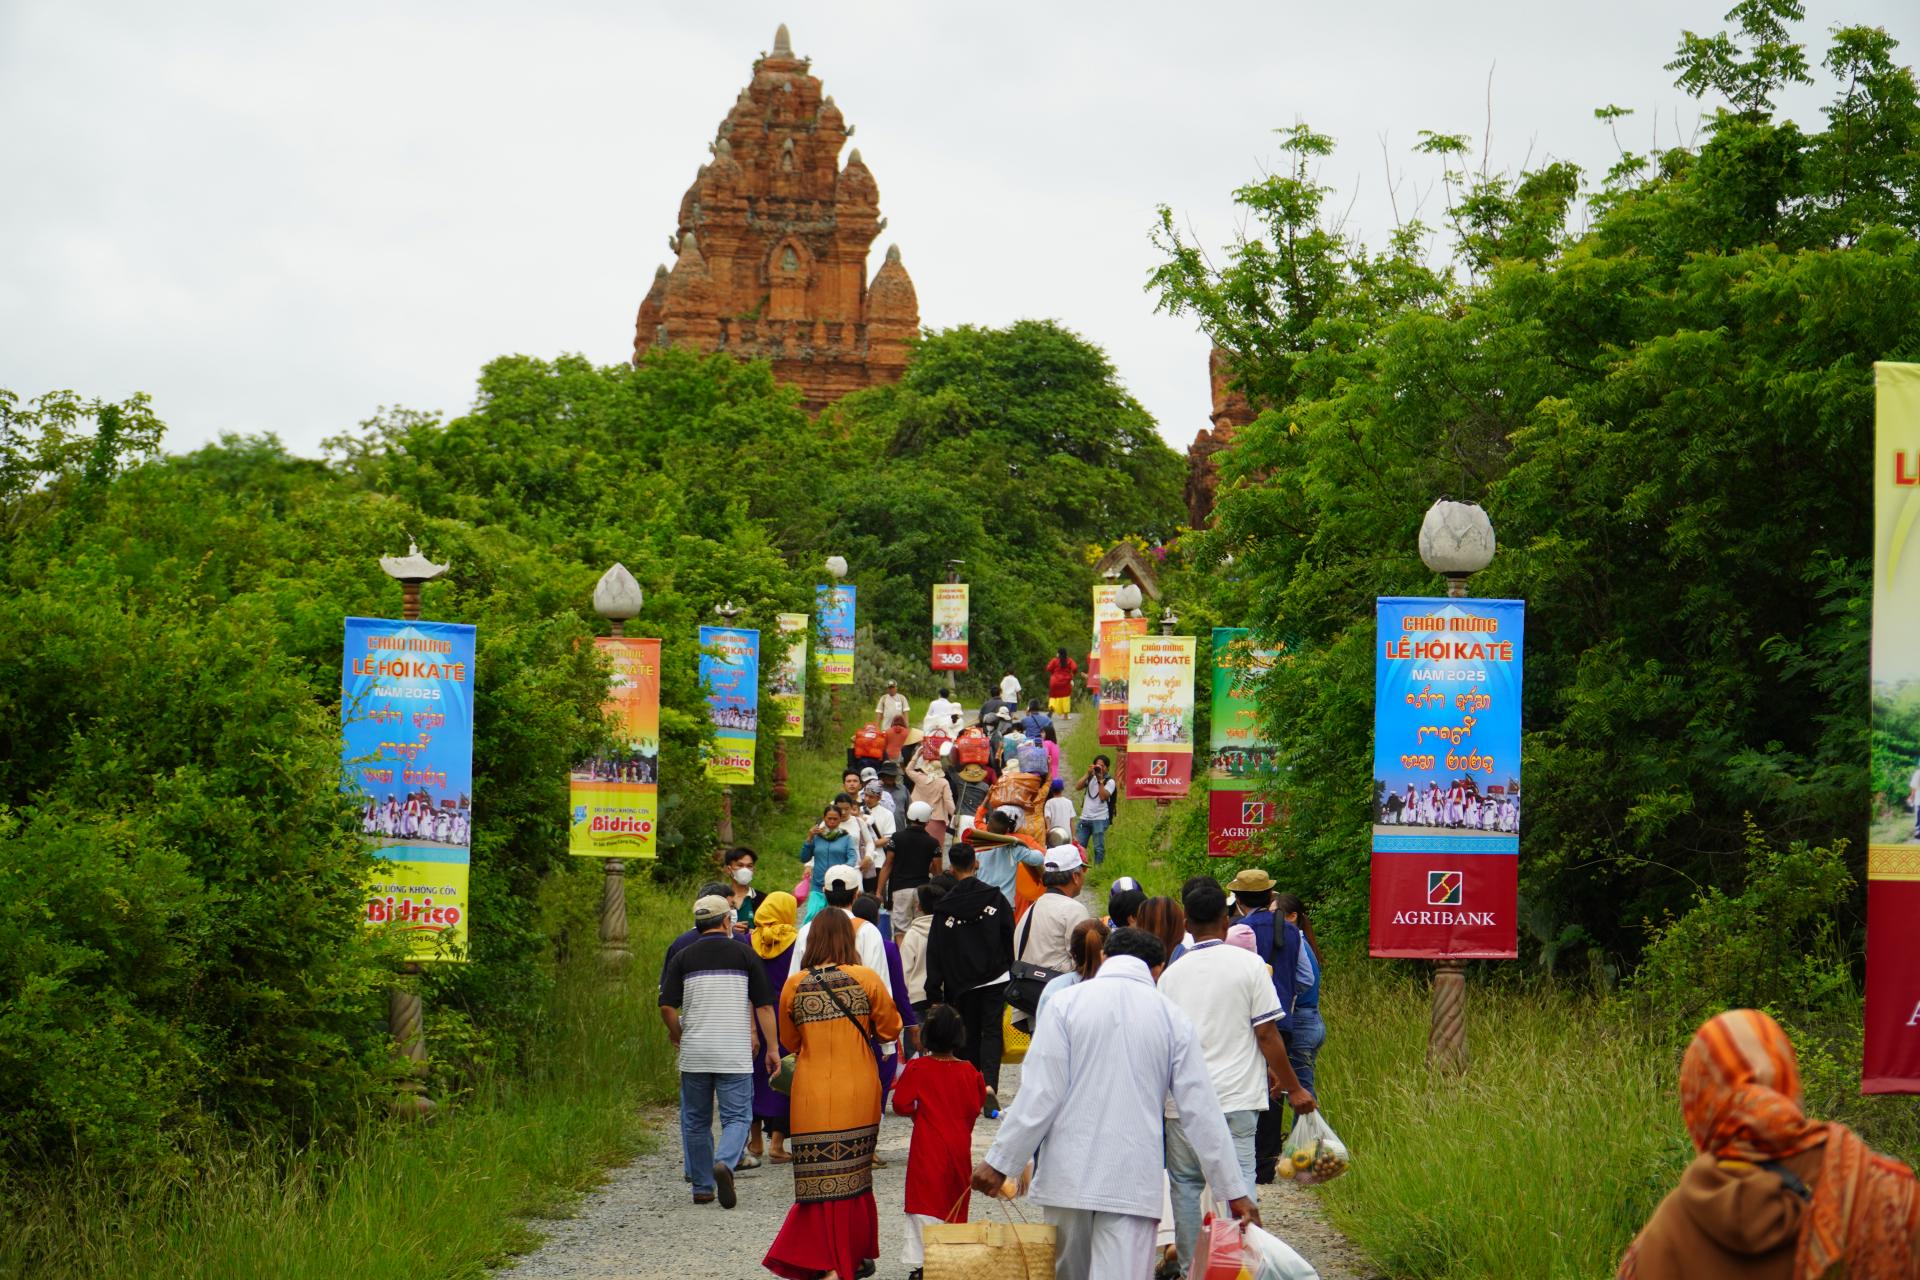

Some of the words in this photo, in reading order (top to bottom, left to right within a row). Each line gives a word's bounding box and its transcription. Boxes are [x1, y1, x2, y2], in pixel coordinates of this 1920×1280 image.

[1403, 613, 1446, 632] CHÀO
[1450, 613, 1498, 633] MỪNG
[1386, 636, 1411, 660] LỄ
[1415, 639, 1451, 662] HỘI
[940, 653, 963, 664] 360
[1147, 654, 1163, 666] HỘI
[378, 657, 410, 680] HỘI
[1412, 667, 1444, 681] NĂM
[1447, 669, 1486, 682] 2025
[374, 685, 403, 698] NĂM
[405, 687, 441, 700] 2025
[1135, 777, 1182, 785] AGRIBANK
[593, 815, 652, 833] Bidrico
[367, 896, 460, 925] Bidrico
[1392, 911, 1497, 926] AGRIBANK
